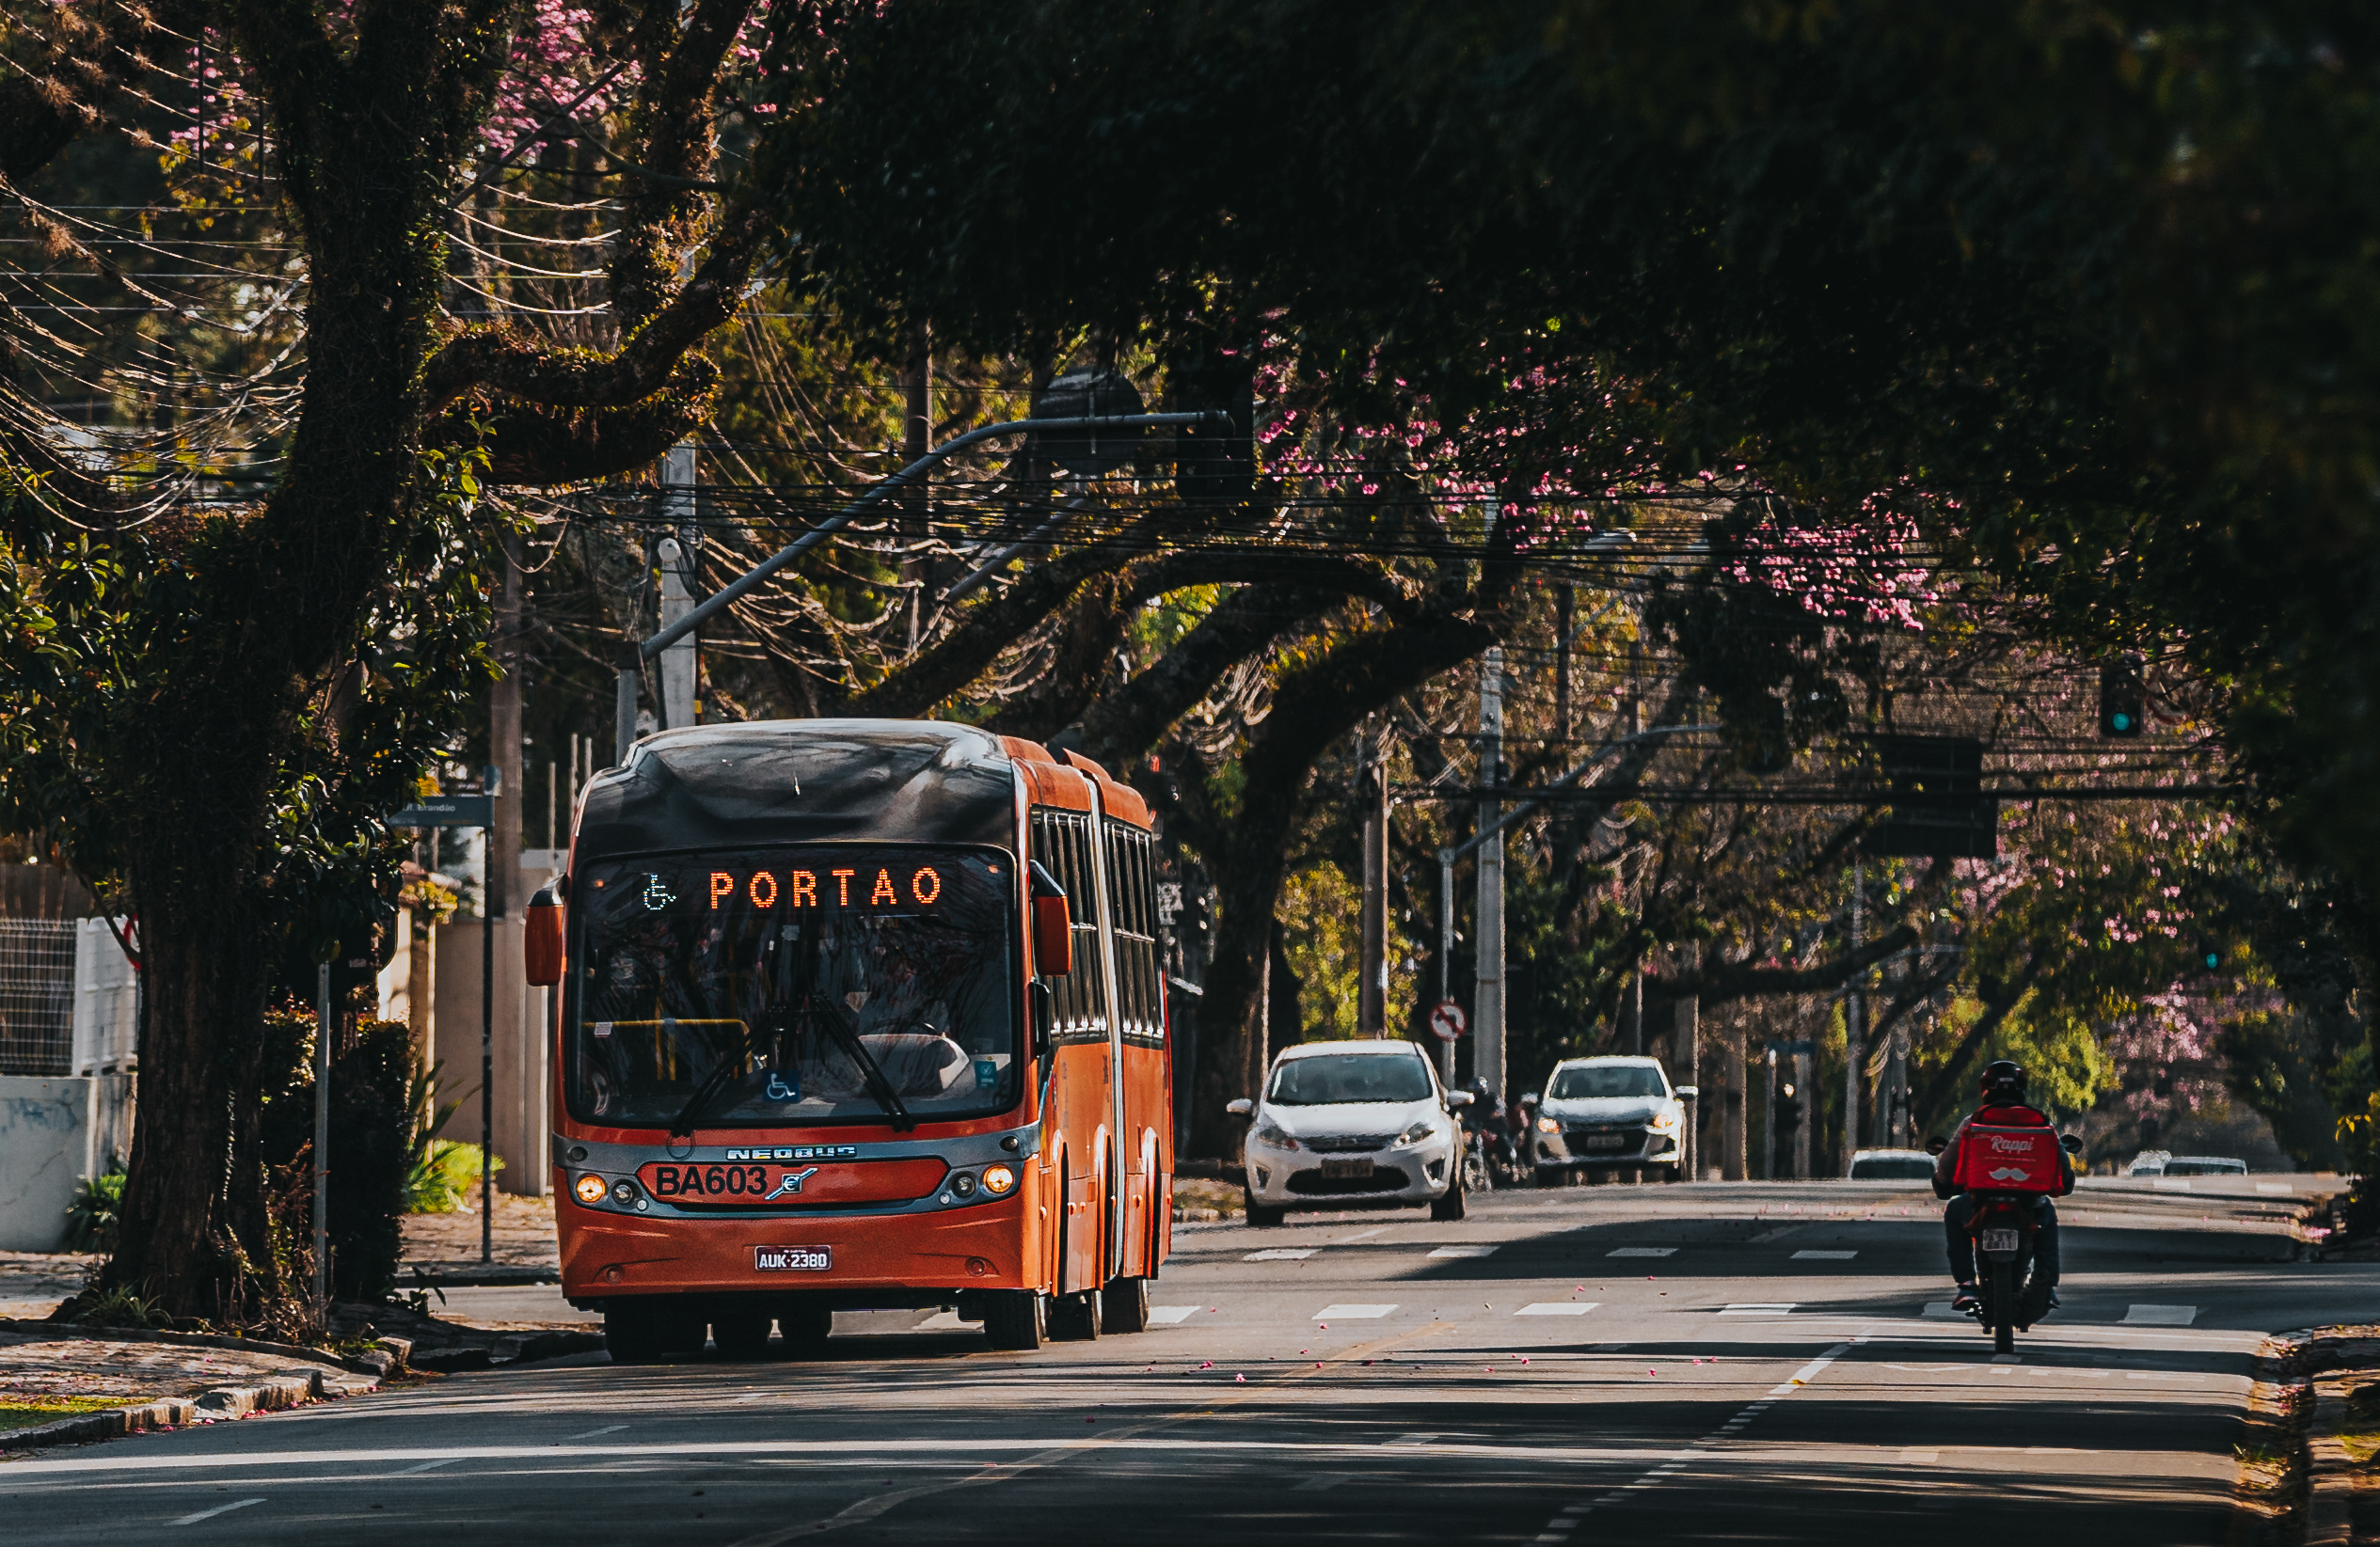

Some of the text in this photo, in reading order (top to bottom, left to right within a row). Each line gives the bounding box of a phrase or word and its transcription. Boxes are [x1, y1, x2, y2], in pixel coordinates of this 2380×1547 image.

[710, 867, 940, 909] PORTAO
[727, 1147, 855, 1159] NEOBUS
[1991, 1135, 2035, 1154] Rappi
[657, 1166, 767, 1195] BA603
